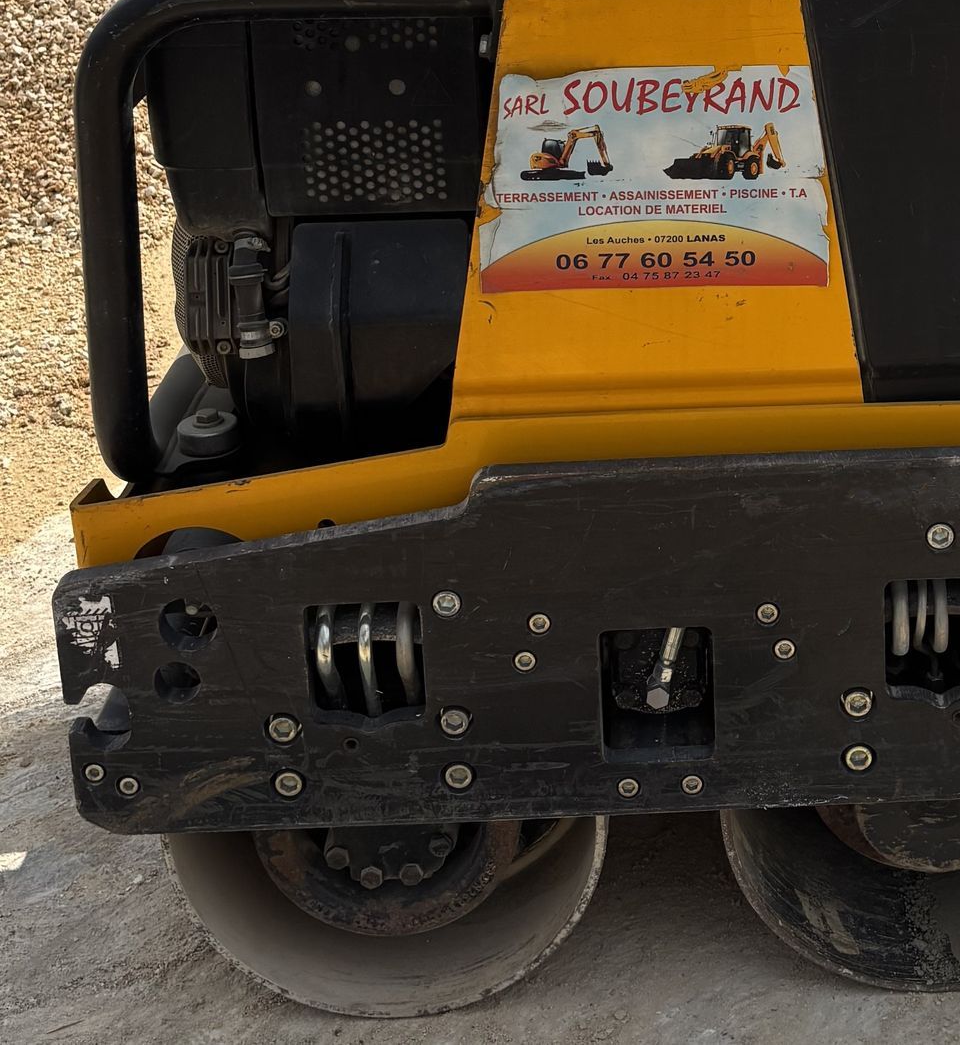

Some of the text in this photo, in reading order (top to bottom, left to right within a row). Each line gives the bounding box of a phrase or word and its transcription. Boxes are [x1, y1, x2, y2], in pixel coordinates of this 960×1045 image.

[503, 76, 801, 120] SARL SOUBEYRAND
[496, 191, 599, 203] TERRASSEMENT
[609, 189, 719, 201] ASSAINISSEMENT
[729, 188, 778, 199] PISCINE
[578, 204, 727, 216] LOCATION DE MATERIEL
[586, 234, 726, 244] Les Auches 07200 LANAS
[556, 250, 756, 270] 06 77 60 54 50
[622, 272, 638, 280] 04
[644, 271, 659, 280] 75
[664, 270, 679, 280] 87
[684, 271, 700, 279] 23
[705, 270, 720, 278] 47
